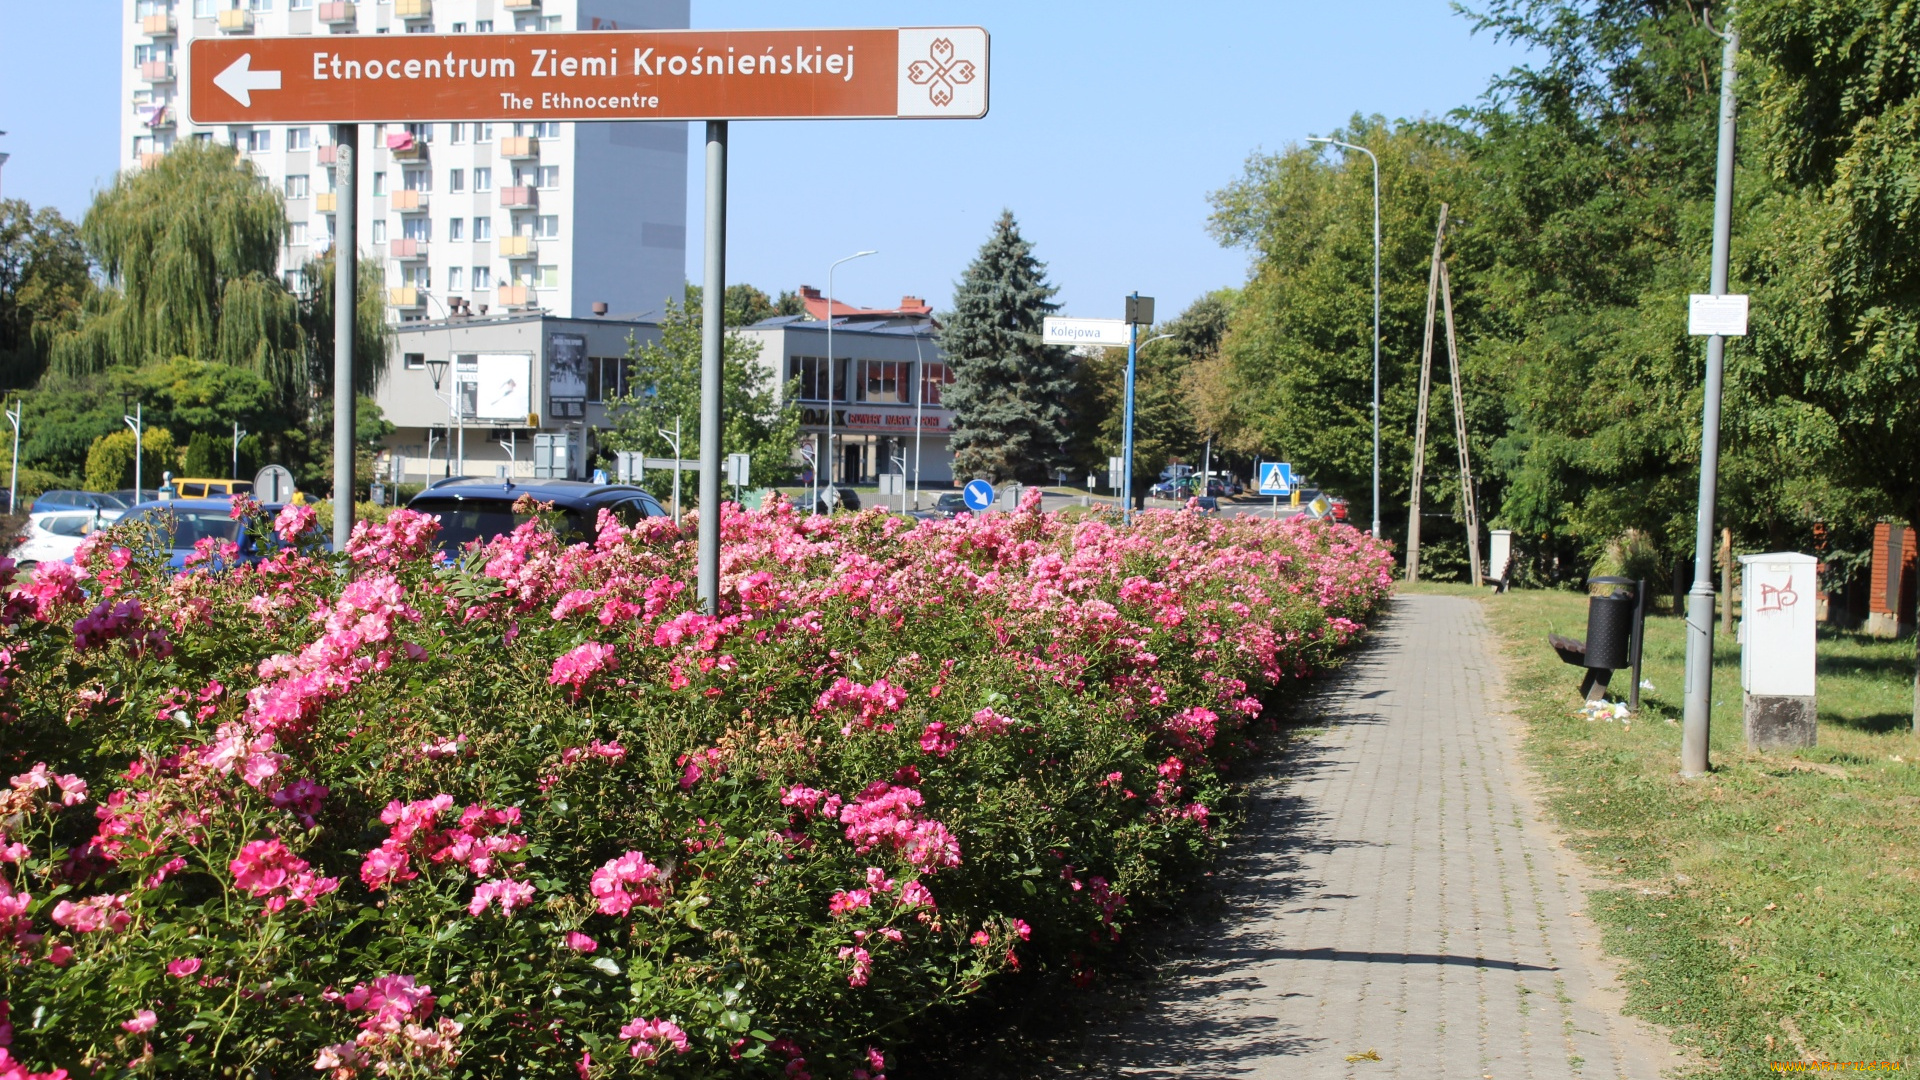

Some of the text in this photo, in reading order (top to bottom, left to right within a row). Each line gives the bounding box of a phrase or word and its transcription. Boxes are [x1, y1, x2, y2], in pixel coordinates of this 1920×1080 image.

[313, 45, 854, 82] Etnocentrum Ziemi Krośnieńskiej
[500, 92, 659, 110] The Ethnocentre
[1051, 326, 1101, 339] Kolejowa
[848, 413, 882, 425] ROWERY
[885, 415, 911, 426] NARTY
